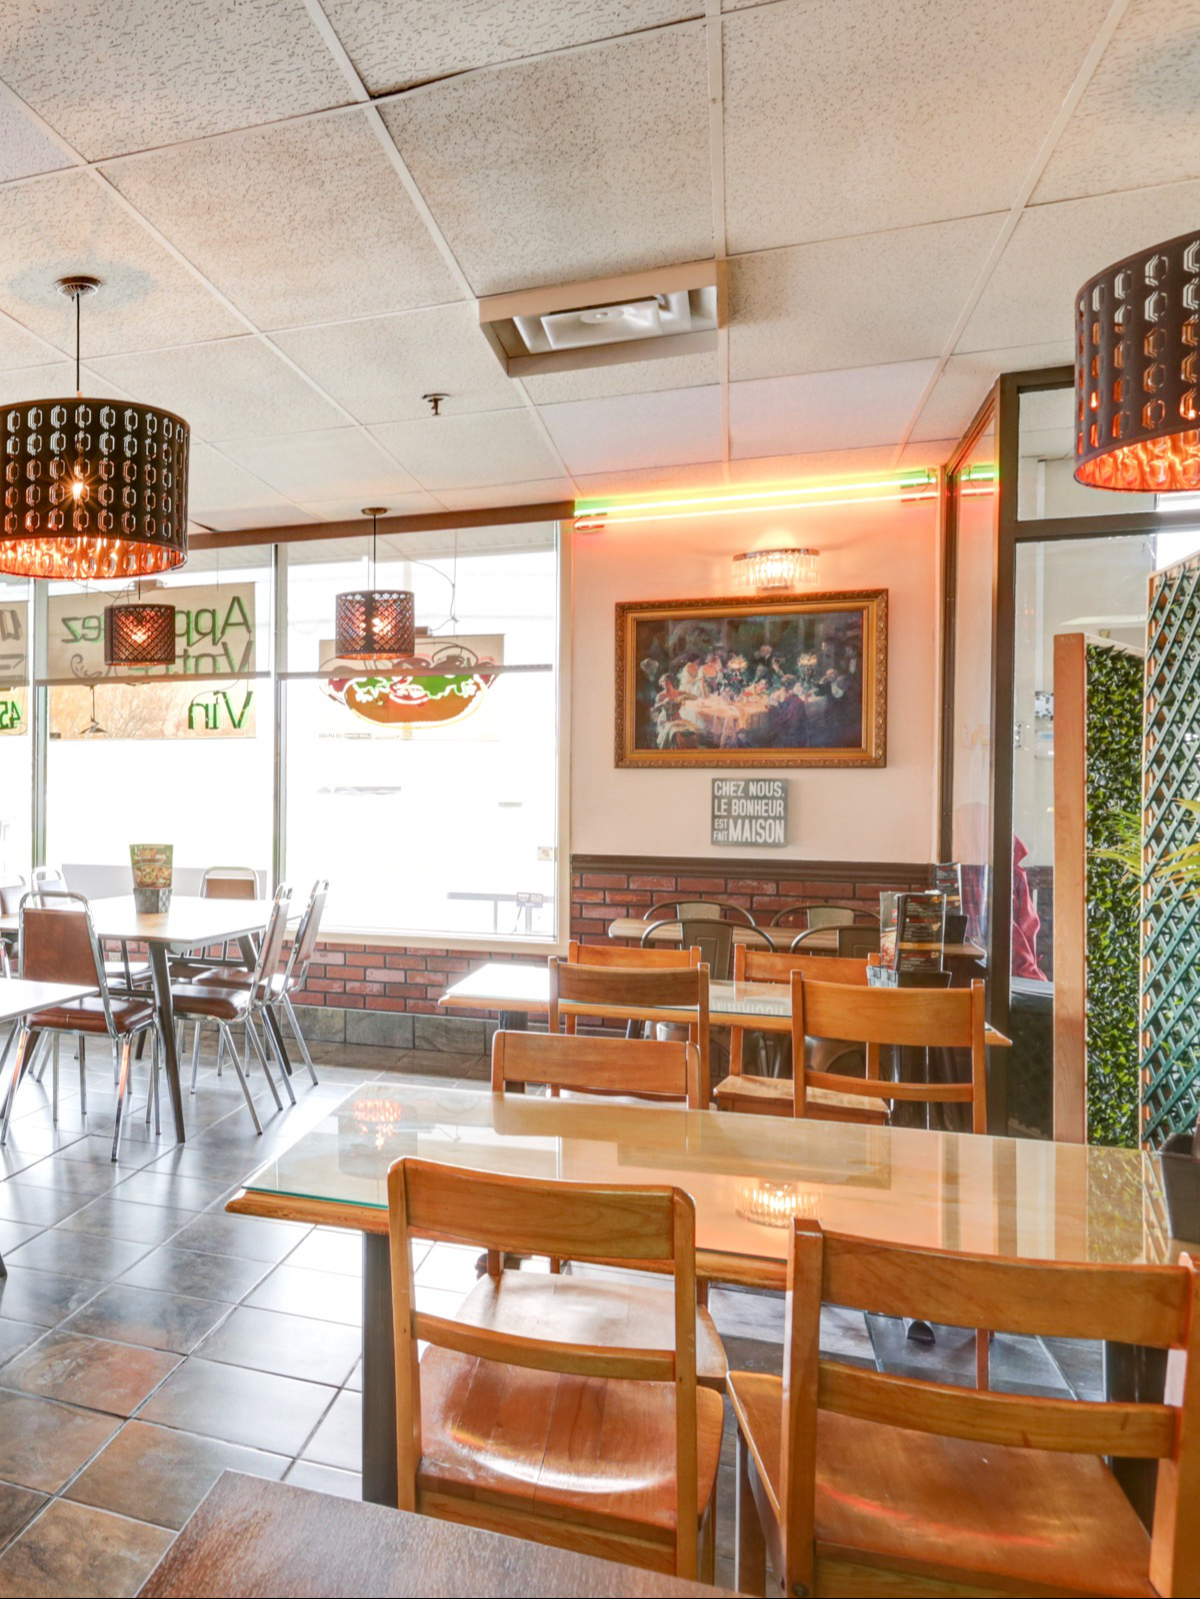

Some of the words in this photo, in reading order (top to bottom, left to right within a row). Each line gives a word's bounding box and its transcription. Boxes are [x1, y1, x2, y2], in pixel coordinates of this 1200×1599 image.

[714, 780, 745, 797] CHEZ
[749, 780, 785, 798] NOUS,
[714, 798, 728, 816] LE
[731, 798, 784, 817] BONHEUR
[714, 818, 728, 830] EST
[728, 818, 785, 843] MAISON
[713, 830, 728, 842] FAIT
